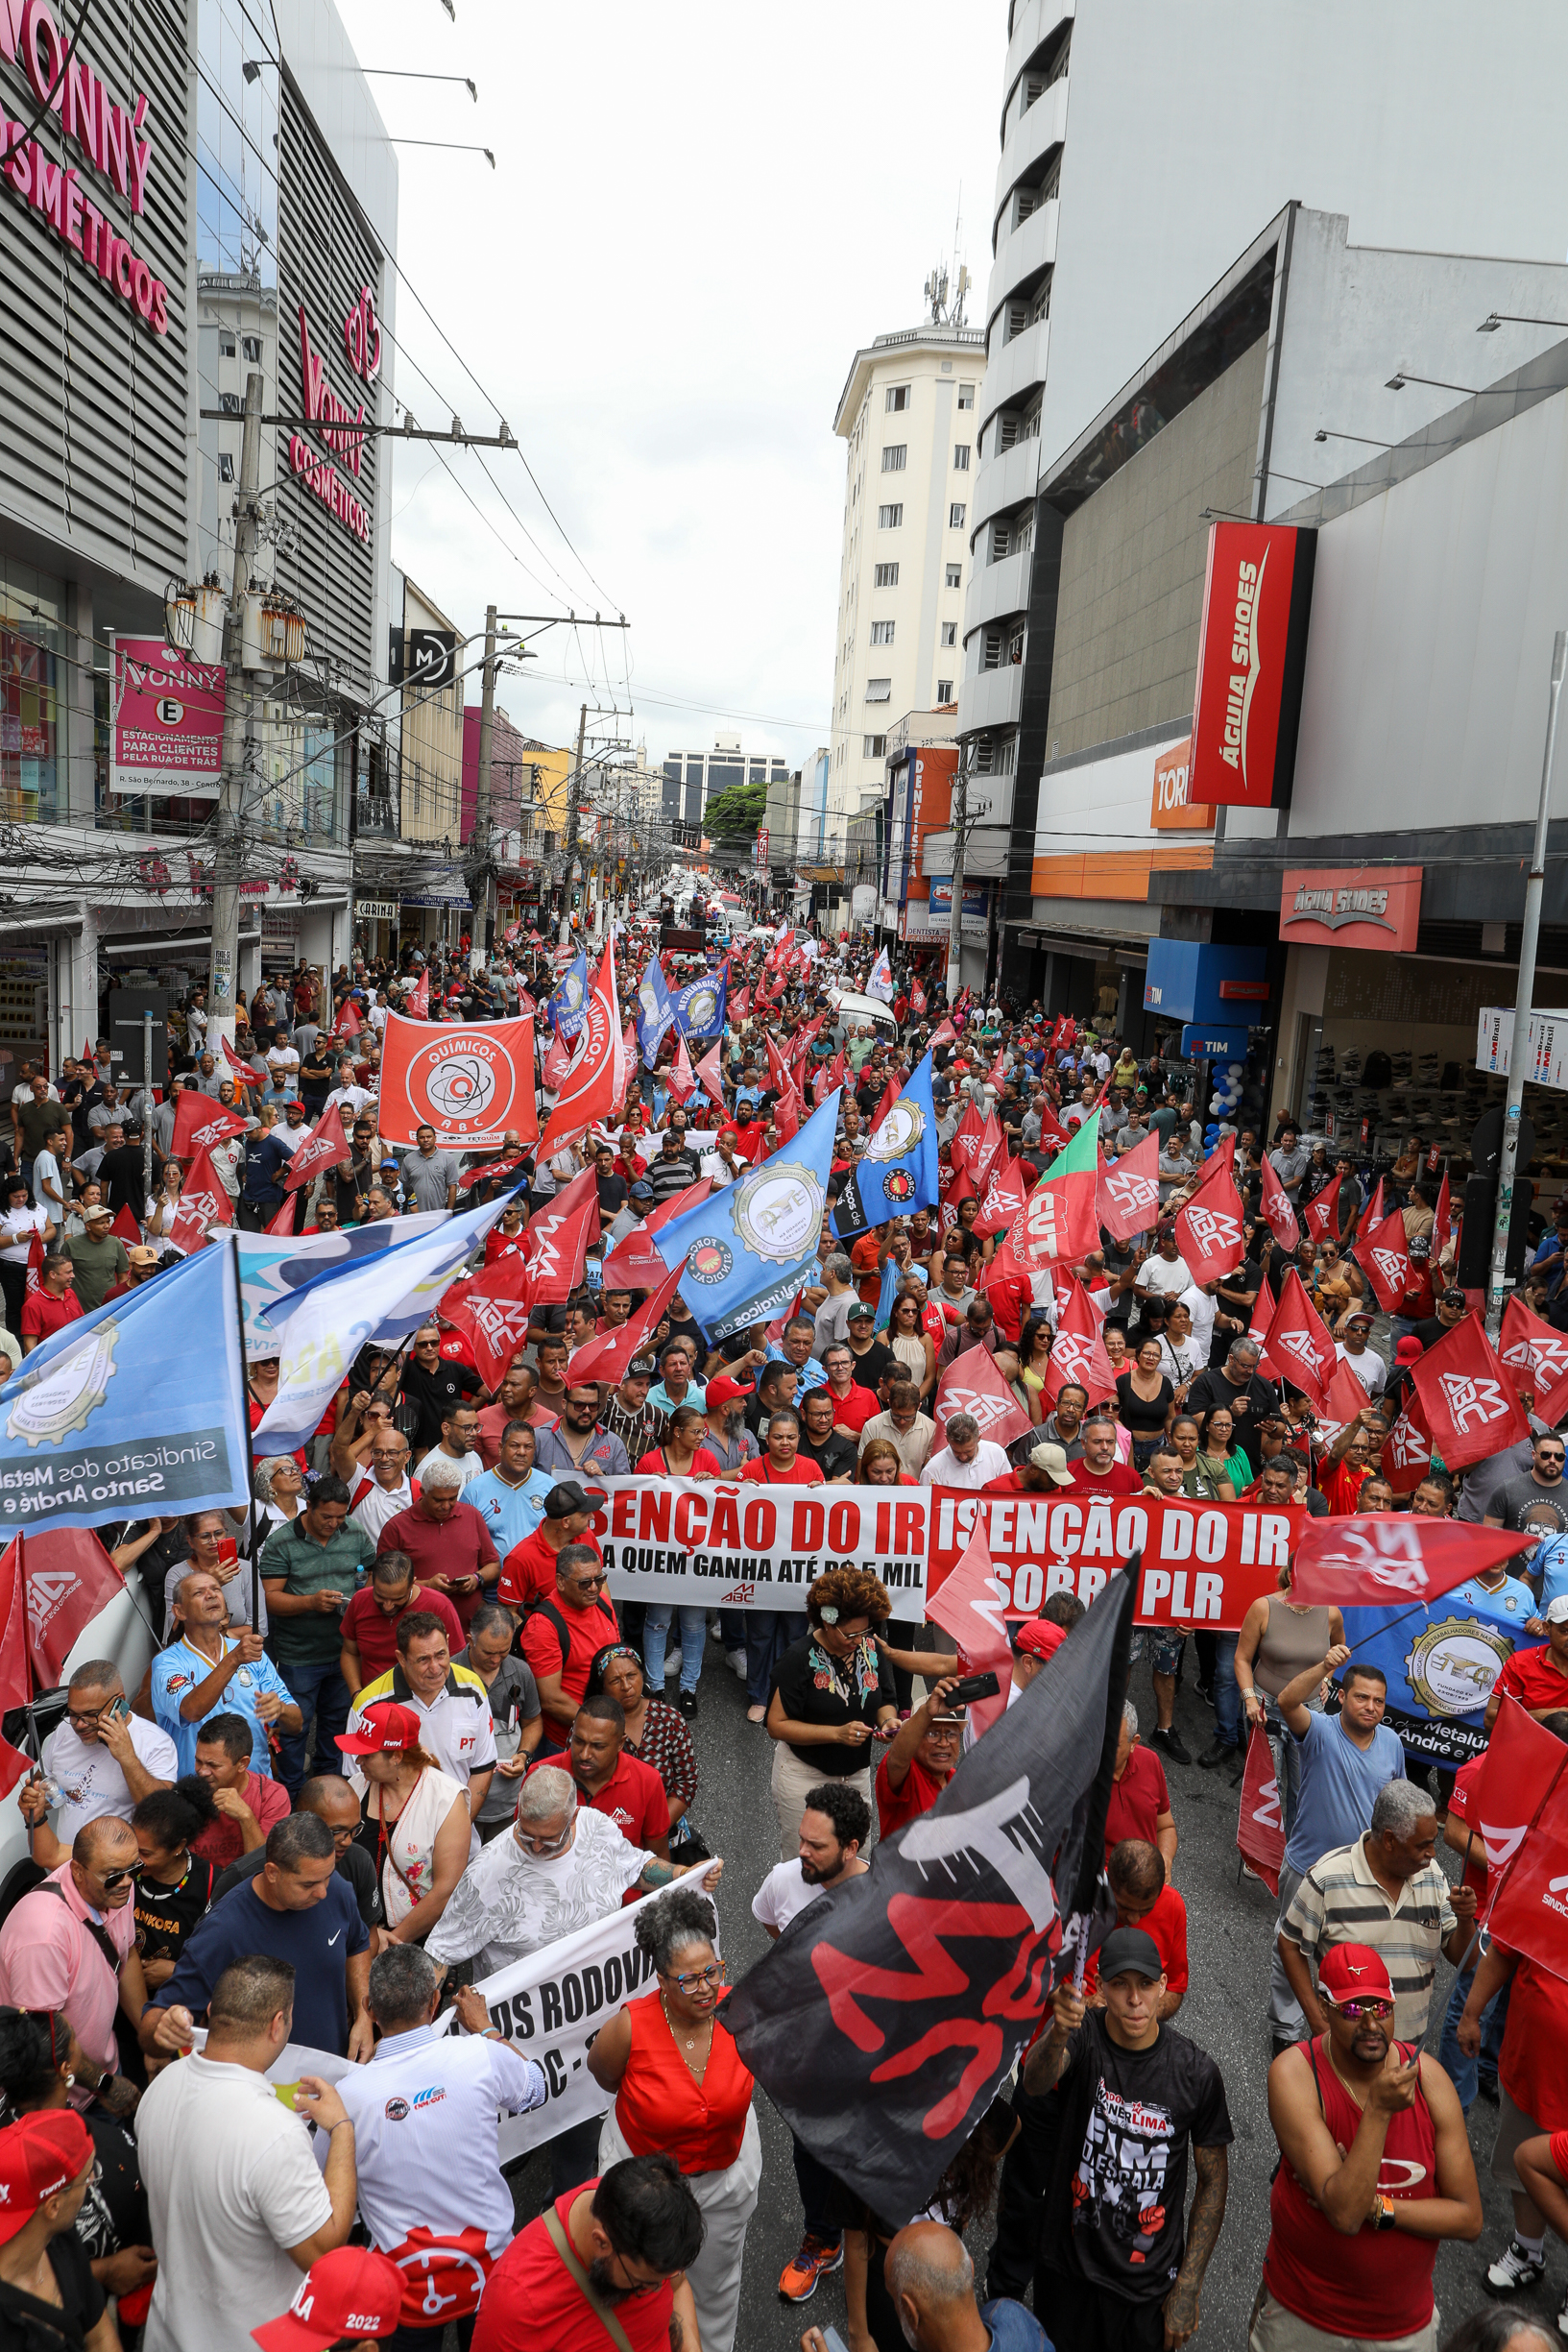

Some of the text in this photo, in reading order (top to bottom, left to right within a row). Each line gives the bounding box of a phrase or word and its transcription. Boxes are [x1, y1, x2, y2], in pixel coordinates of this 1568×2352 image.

[290, 435, 370, 544] COSMÉTICOS
[1218, 559, 1258, 769] ÁGUIA SHOES
[162, 700, 178, 721] E
[122, 731, 219, 745] ESTACIONAMENTO
[123, 741, 218, 757] PARA CLIENTES
[123, 753, 217, 766] PELA RUA DE TRÁS
[144, 777, 180, 787] Bernardo,
[908, 759, 925, 878] DENTISTA
[359, 904, 394, 917] CARINA
[1293, 884, 1388, 915] ÁGUIA SHOES
[908, 928, 940, 936] DENTISTA
[1151, 987, 1163, 1005] TIM
[428, 1039, 497, 1064] QUÍMICOS
[1205, 1041, 1228, 1054] TIM
[883, 1171, 901, 1202] SINDICAL
[903, 1172, 915, 1197] FORÇA
[1027, 1192, 1058, 1259] CUT
[1188, 1205, 1227, 1257] ABC
[1011, 1228, 1025, 1262] PAULO
[446, 1344, 460, 1354] 13
[1501, 1358, 1524, 1370] SINDICATO
[1443, 1371, 1489, 1434] ABC
[583, 1485, 925, 1557] SENÇÃO DO IR
[938, 1494, 1149, 1566] ISENÇÃO
[1160, 1508, 1229, 1564] DO
[1240, 1513, 1291, 1567] IR
[622, 1546, 924, 1588] QUEM GANHA ATÉ MIL
[721, 1592, 756, 1605] ABC
[995, 1562, 1224, 1620] SOBR PLR
[1416, 1652, 1425, 1683] SINDICATO
[1422, 1640, 1433, 1653] DOS
[1431, 1628, 1480, 1645] TRABALHADORES
[1480, 1630, 1492, 1642] NAS
[1423, 1690, 1439, 1706] SANTO
[1438, 1702, 1457, 1713] ANDRÉ
[460, 1737, 476, 1750] PT
[1397, 1728, 1465, 1758] André e
[1424, 1722, 1490, 1750] Metalúr
[1133, 2113, 1168, 2132] LIMA
[1096, 2153, 1166, 2191] ESCALA
[345, 2313, 381, 2332] 2022
